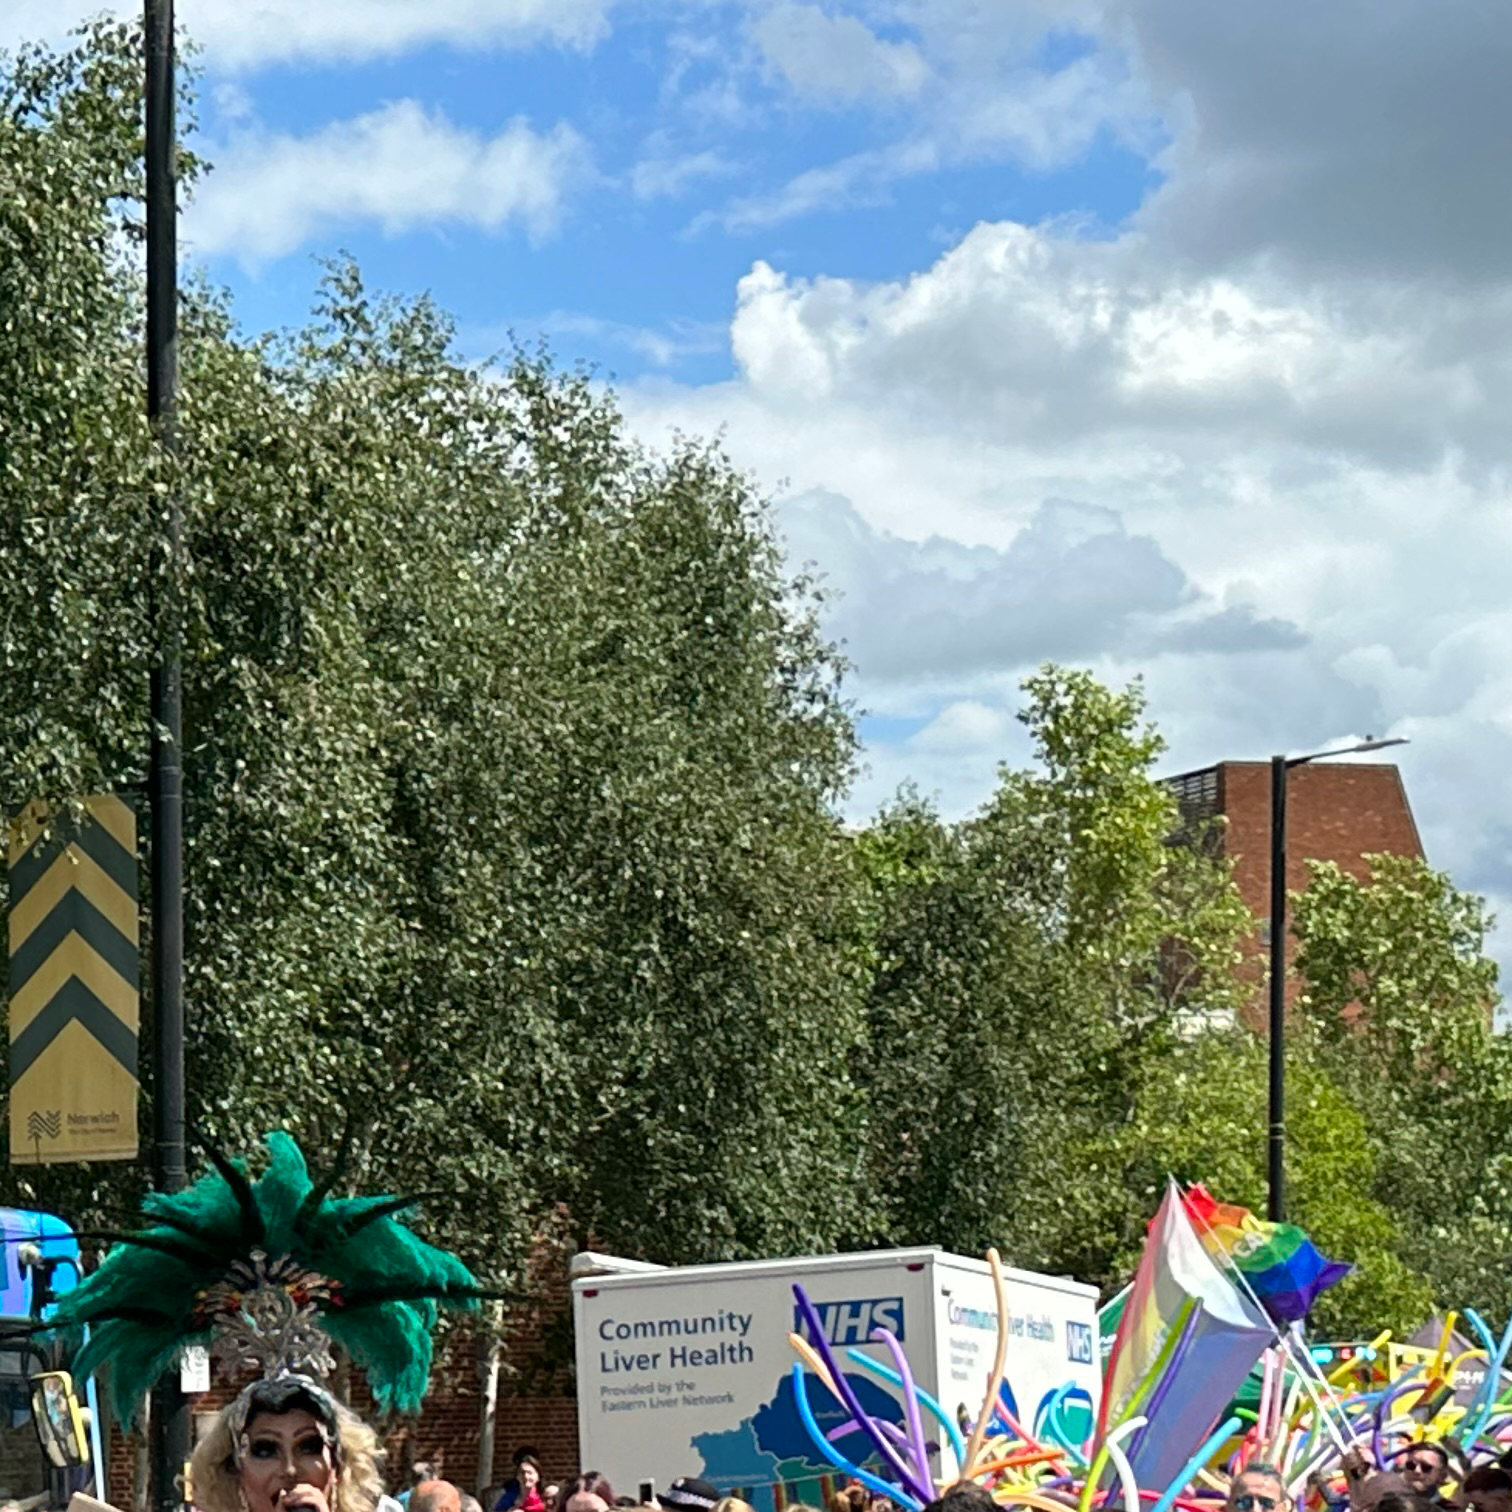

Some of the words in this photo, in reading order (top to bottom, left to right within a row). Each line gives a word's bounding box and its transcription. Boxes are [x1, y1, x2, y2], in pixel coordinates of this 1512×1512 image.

[598, 1309, 753, 1341] Community
[600, 1351, 661, 1373] Liver
[669, 1342, 754, 1369] Health
[1068, 1322, 1092, 1362] NHS
[600, 1382, 654, 1397] Provided
[657, 1380, 672, 1395] by
[675, 1379, 696, 1392] the
[649, 1396, 679, 1410] Liver
